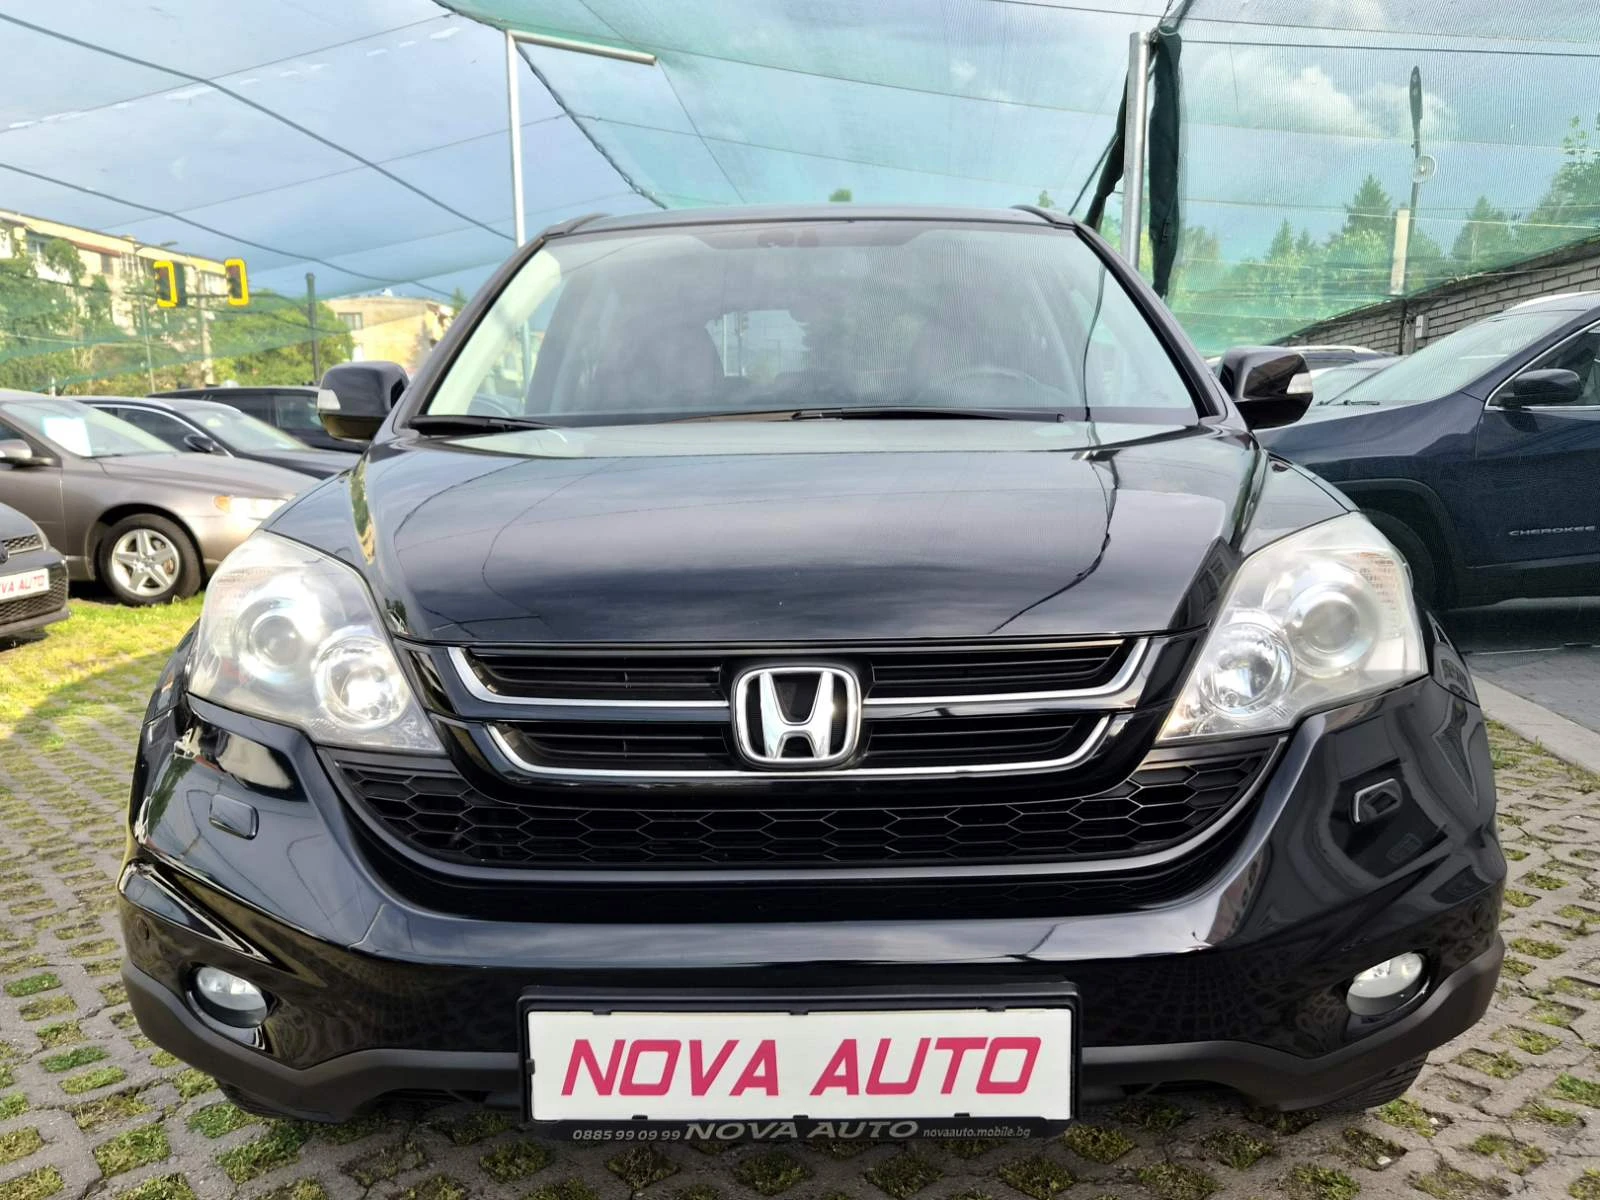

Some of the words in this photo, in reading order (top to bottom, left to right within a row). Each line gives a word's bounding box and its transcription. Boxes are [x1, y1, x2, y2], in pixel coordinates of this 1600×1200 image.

[1508, 525, 1596, 536] CHEROKEE
[561, 1038, 779, 1096] NOVA
[810, 1037, 1041, 1095] AUTO
[572, 1129, 612, 1140] 0885
[615, 1129, 634, 1141] 99
[637, 1130, 658, 1141] 09
[661, 1130, 681, 1141] 99
[684, 1122, 798, 1140] NOVA
[806, 1120, 919, 1139] AUTO
[923, 1126, 1031, 1138] novaauto.mobile.bg
